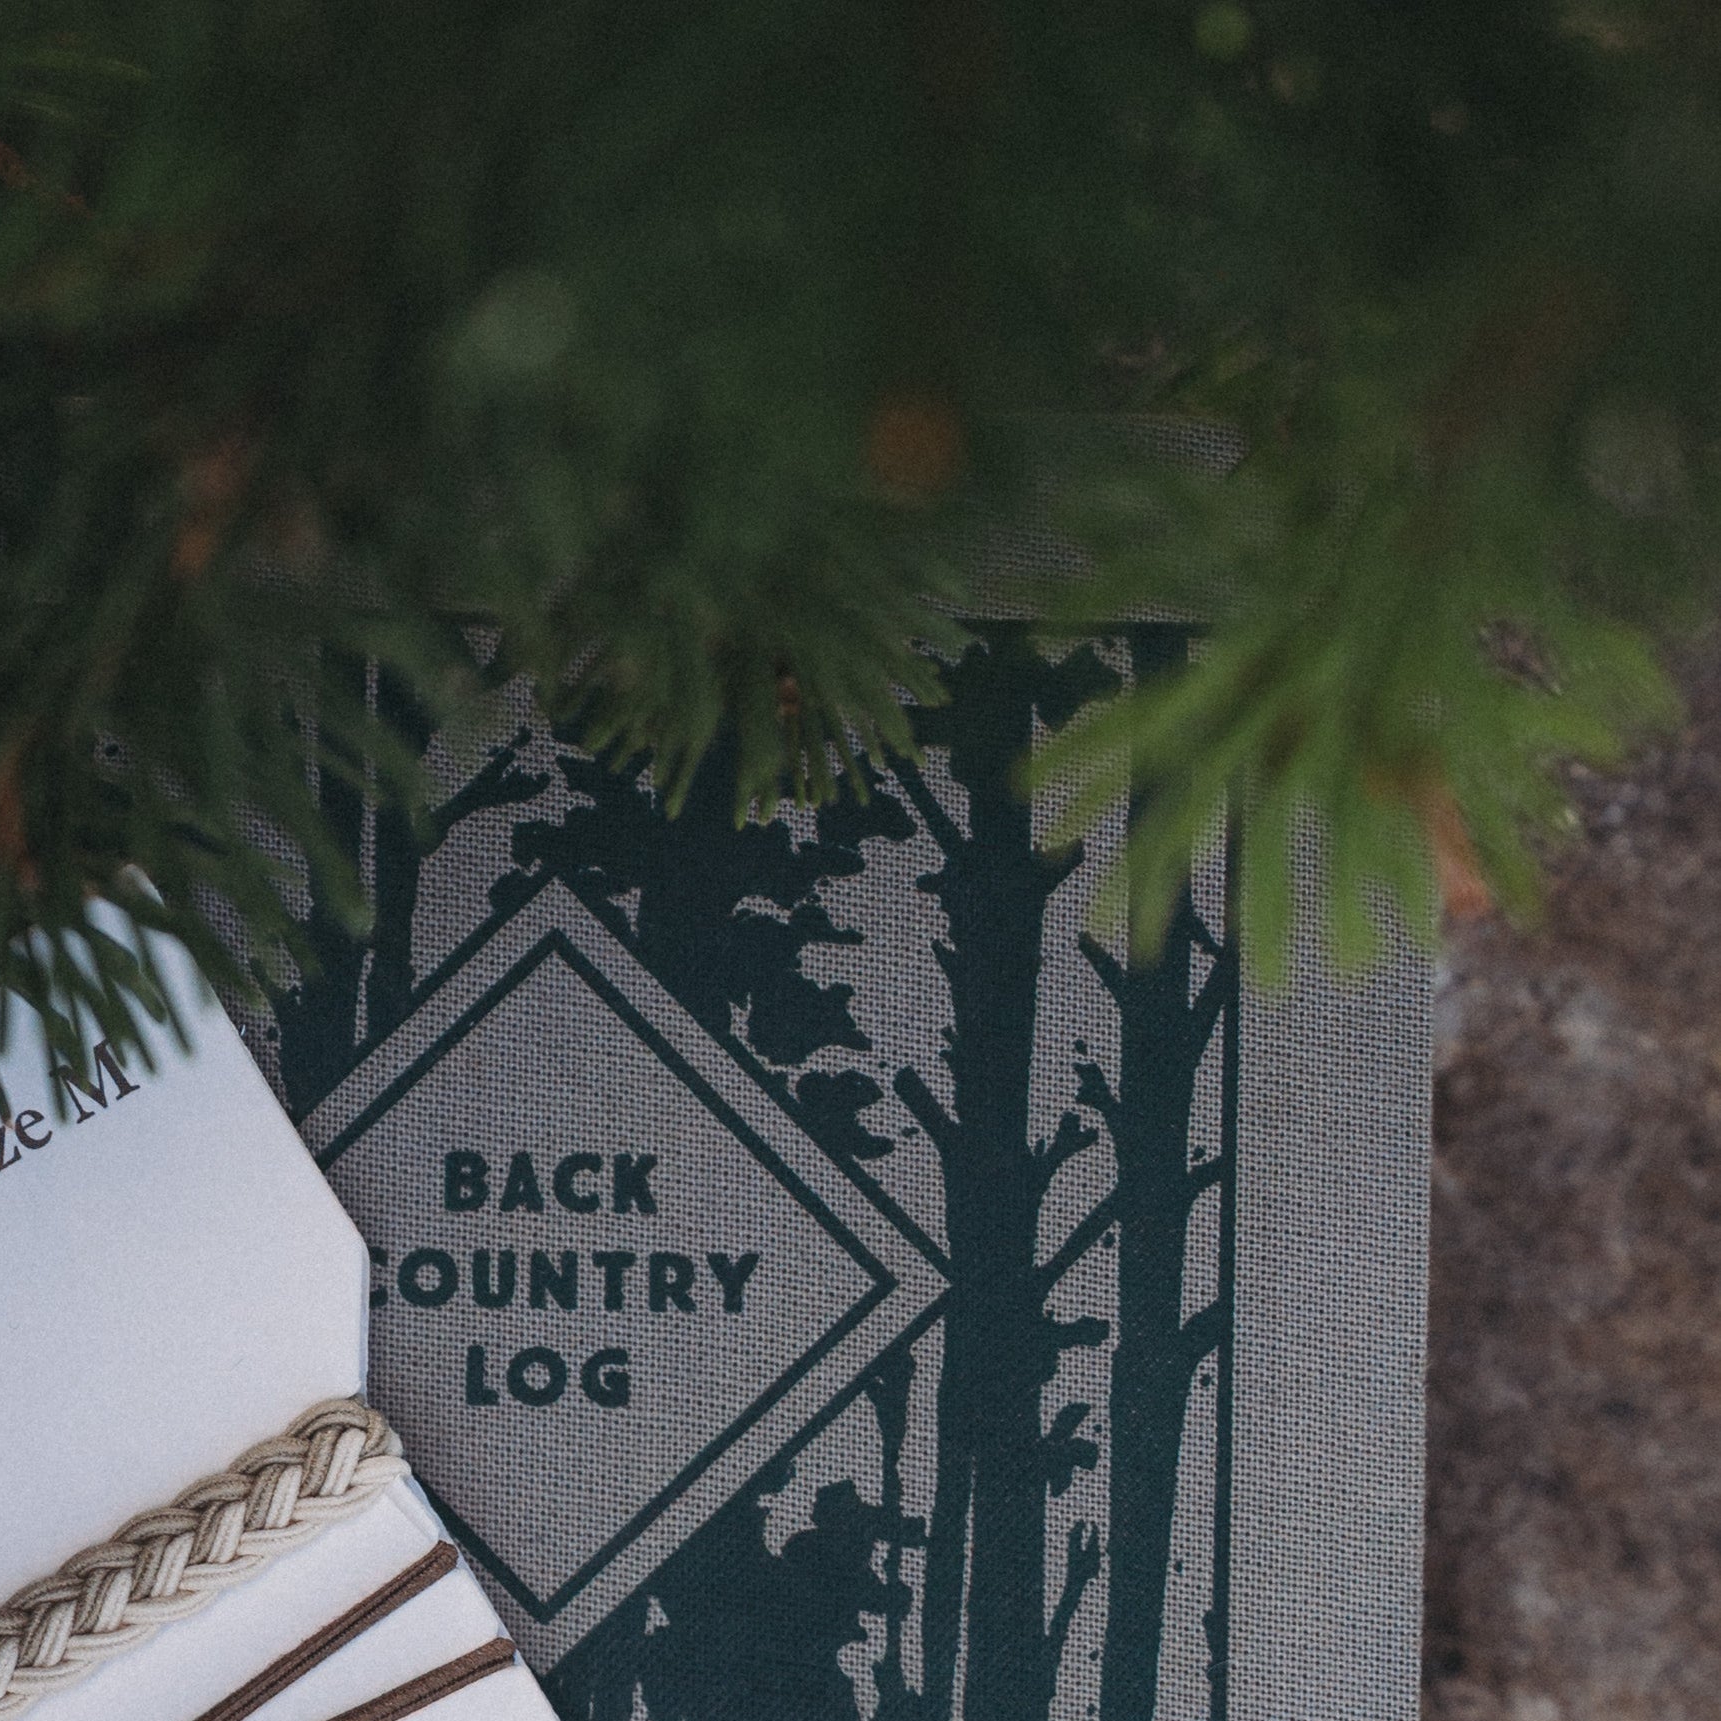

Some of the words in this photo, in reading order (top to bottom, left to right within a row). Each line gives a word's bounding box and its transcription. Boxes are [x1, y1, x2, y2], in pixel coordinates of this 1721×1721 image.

[49, 1039, 141, 1124] M
[443, 1150, 658, 1214] BACK
[465, 1345, 631, 1408] LOG
